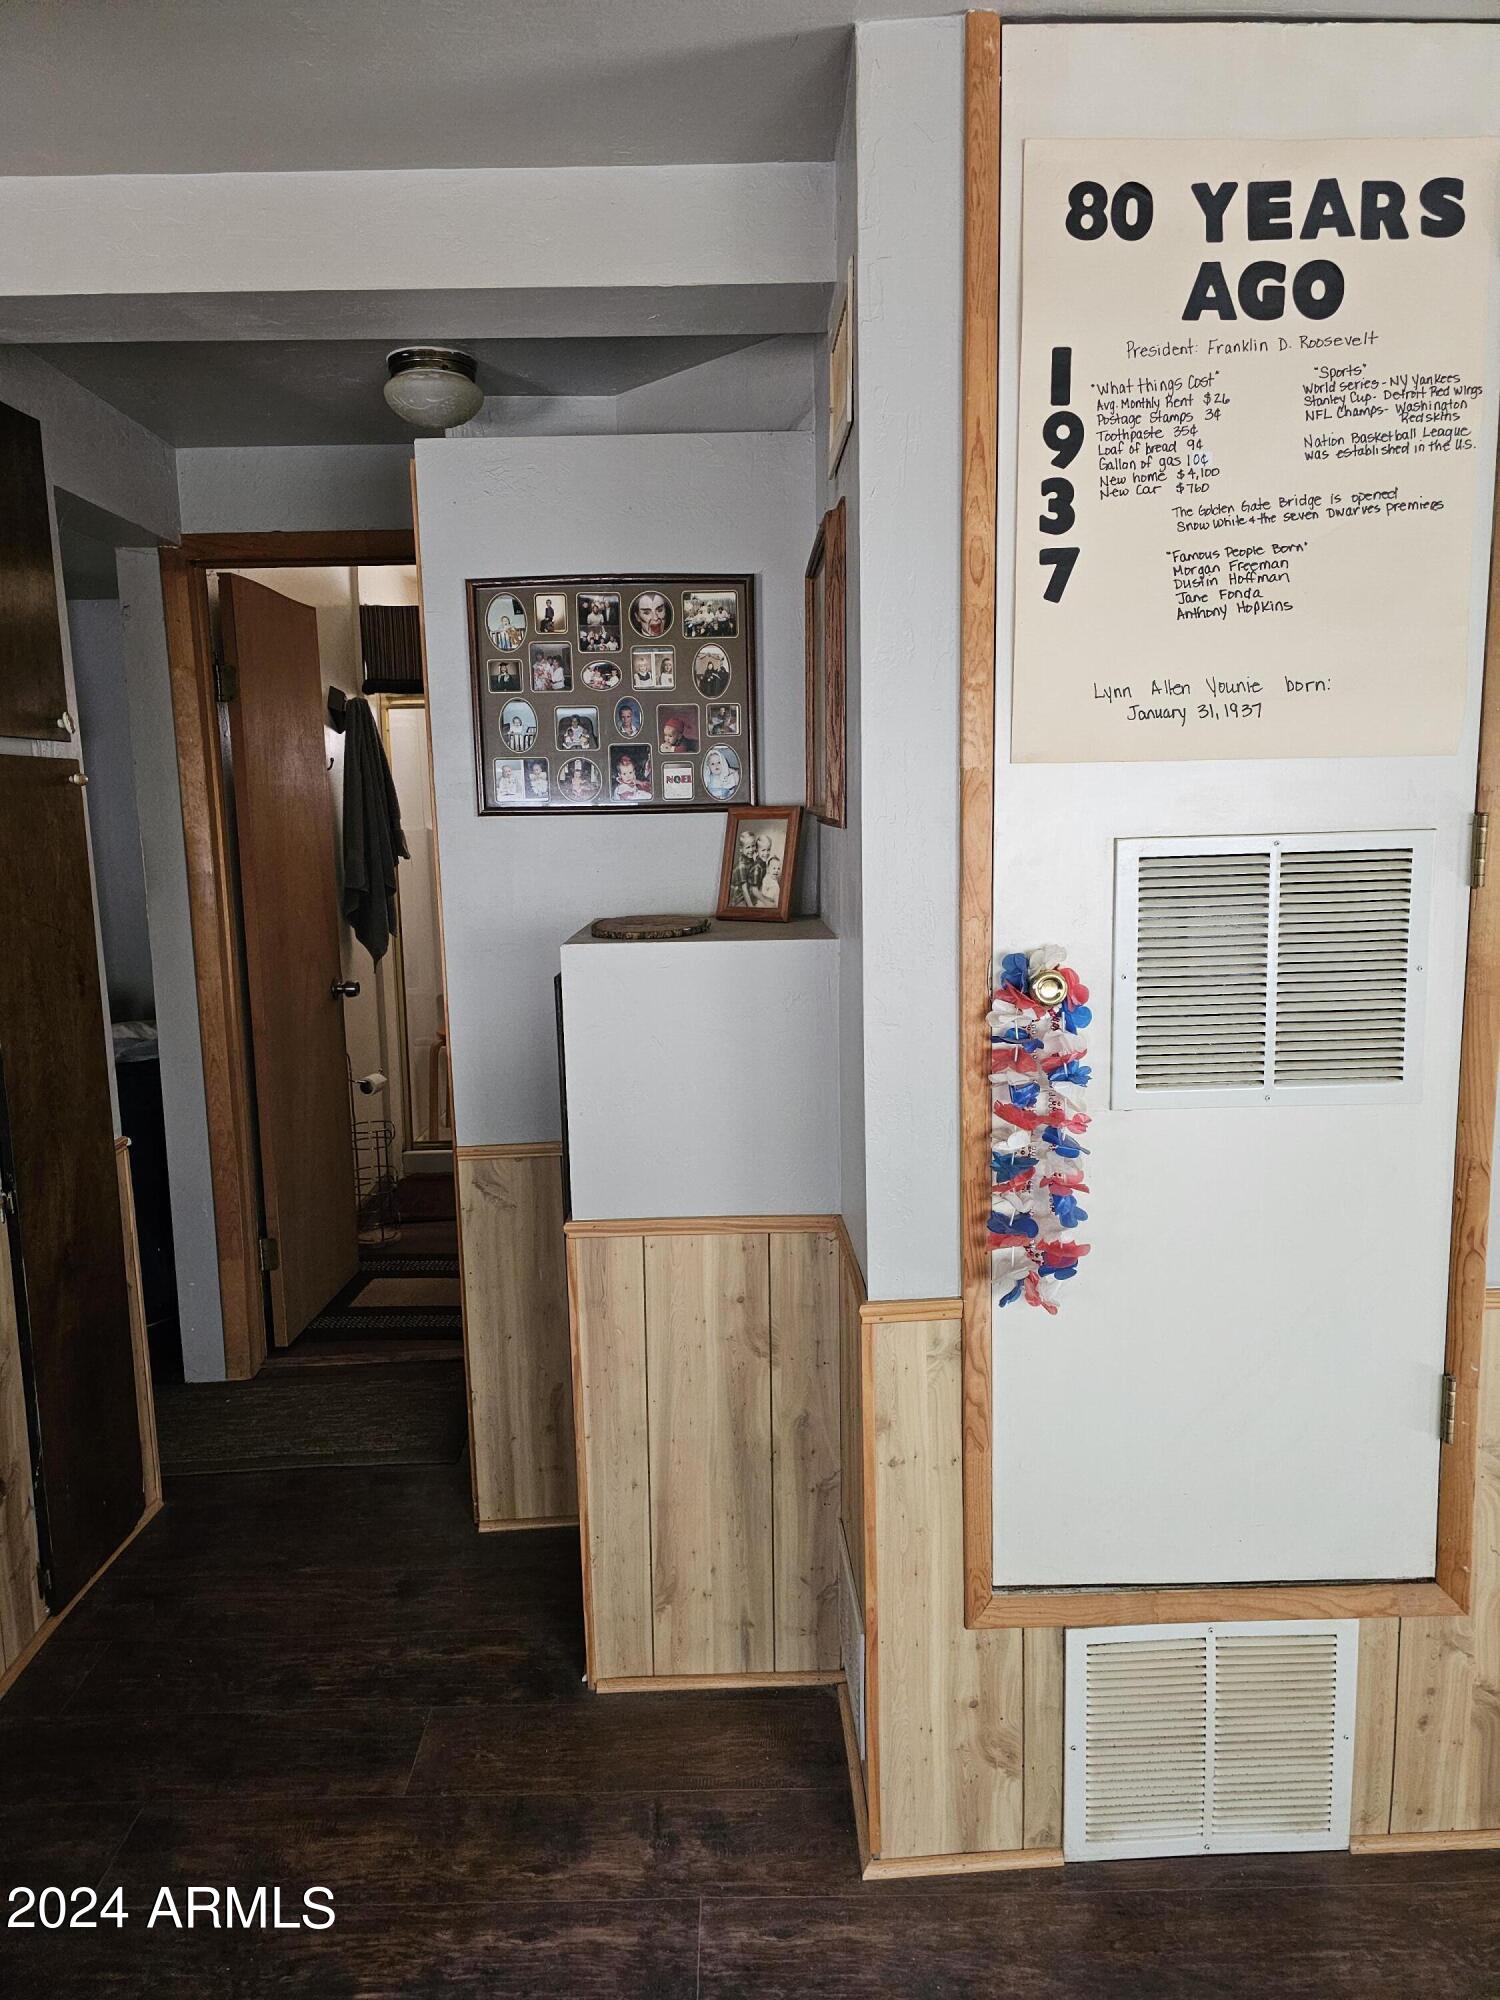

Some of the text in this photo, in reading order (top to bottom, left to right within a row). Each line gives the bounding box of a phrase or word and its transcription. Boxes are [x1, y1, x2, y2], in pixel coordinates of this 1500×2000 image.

[1065, 177, 1466, 243] 80 YEARS
[1181, 259, 1345, 321] AGO
[1126, 330, 1379, 359] President: Franklin D. Roosevelt
[1137, 377, 1183, 396] things
[1302, 380, 1336, 395] World
[1389, 374, 1408, 391] NY
[1096, 398, 1119, 414] Avg.
[1121, 396, 1160, 413] Monthly
[1165, 393, 1194, 408] Rent
[1303, 393, 1346, 407] Stanley
[1383, 386, 1427, 400] Detroit
[1430, 385, 1450, 397] Red
[1097, 412, 1142, 429] Postage
[1149, 409, 1194, 425] Stamps
[1305, 409, 1333, 422] NFL
[1395, 399, 1468, 415] Washington
[1096, 426, 1165, 442] Toothpaste
[1303, 426, 1472, 448] Nation Basketball League
[1098, 441, 1125, 456] Loaf
[1128, 442, 1141, 455] of
[1145, 440, 1177, 455] bread
[1304, 451, 1330, 461] was
[1414, 440, 1425, 453] in
[1428, 439, 1451, 452] the
[1455, 438, 1477, 450] U.S.
[1099, 456, 1137, 471] Gallon
[1140, 455, 1153, 469] of
[1159, 456, 1181, 472] gas
[1099, 476, 1127, 488] New
[1132, 471, 1168, 484] home
[1099, 487, 1130, 501] New
[1172, 487, 1399, 518] The Golden Gate Bridge is opened
[1176, 521, 1210, 533] Snow
[1257, 513, 1277, 525] the
[1326, 504, 1382, 519] Dwarves
[1224, 546, 1266, 559] People
[1173, 559, 1289, 579] Morgan Freeman
[1173, 571, 1290, 590] Dustin Hoffman
[1175, 587, 1264, 605] Jane Fonda
[1176, 600, 1294, 621] Anthony Hopkins
[1093, 676, 1331, 703] Lynn Allen Younie born:
[1126, 704, 1186, 727] January
